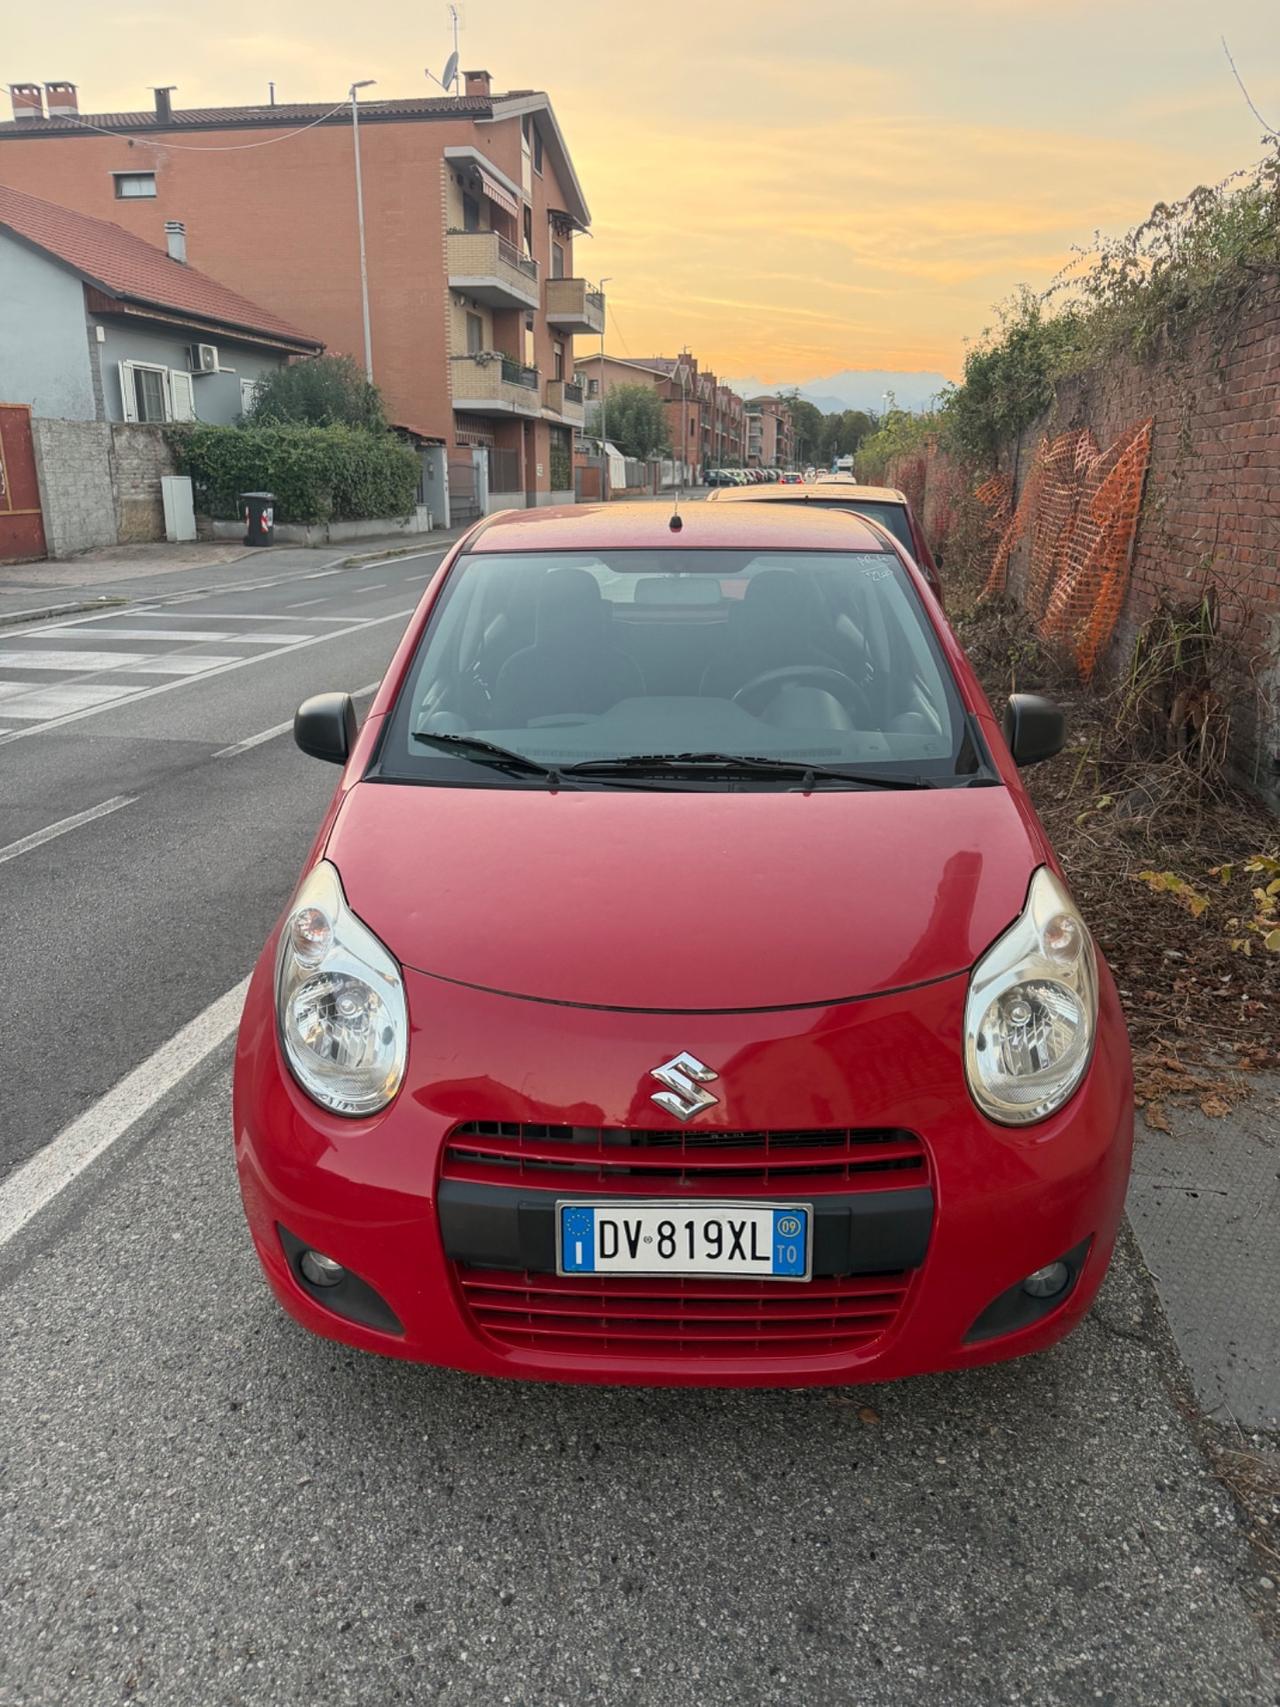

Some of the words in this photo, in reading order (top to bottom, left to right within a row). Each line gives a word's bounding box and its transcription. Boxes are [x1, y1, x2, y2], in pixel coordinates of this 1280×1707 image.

[782, 1220, 796, 1233] 09
[599, 1220, 643, 1259] DV
[657, 1220, 771, 1261] 819XL
[776, 1244, 797, 1264] TO
